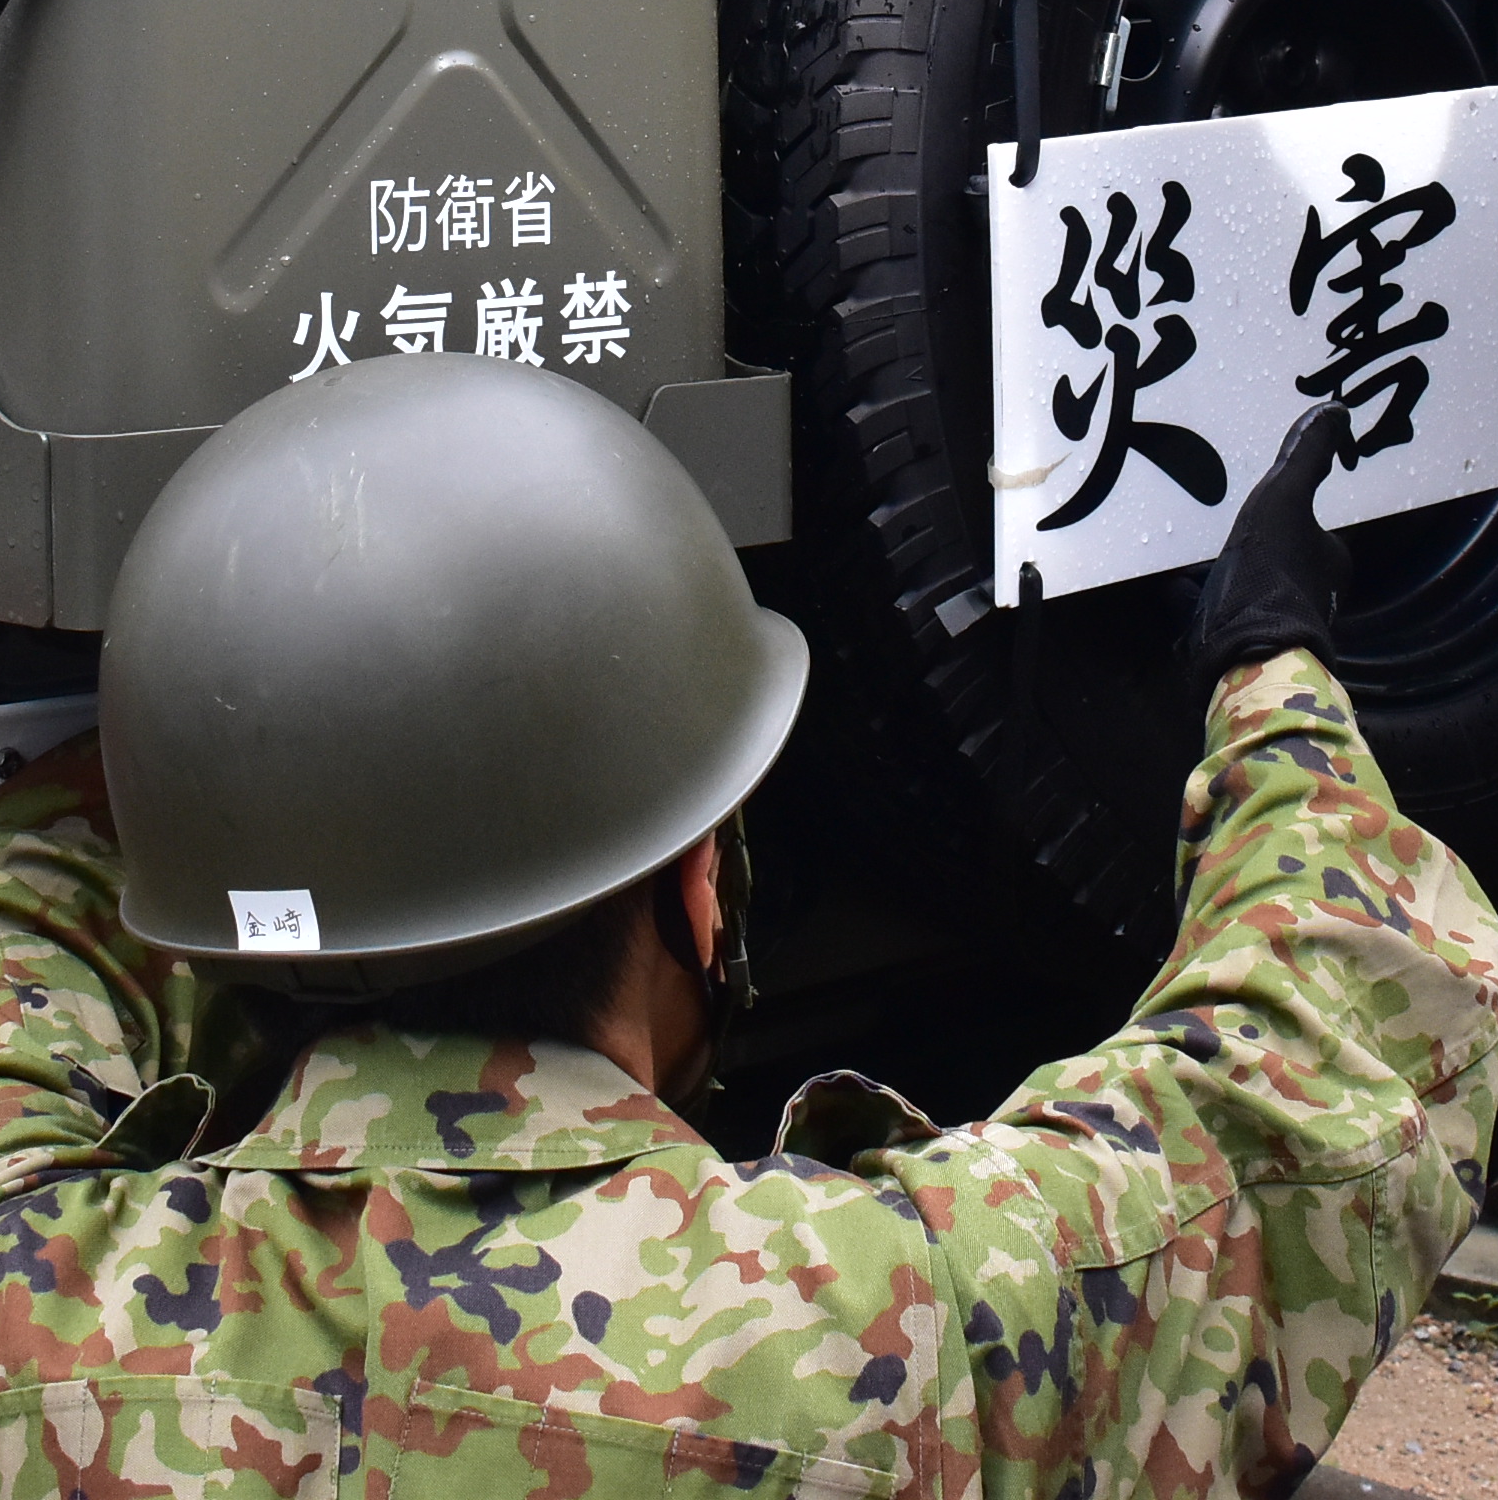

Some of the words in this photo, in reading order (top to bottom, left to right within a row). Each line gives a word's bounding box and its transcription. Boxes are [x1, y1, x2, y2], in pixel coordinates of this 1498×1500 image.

[370, 171, 556, 255] 防衛省
[288, 270, 632, 383] 火気厳禁
